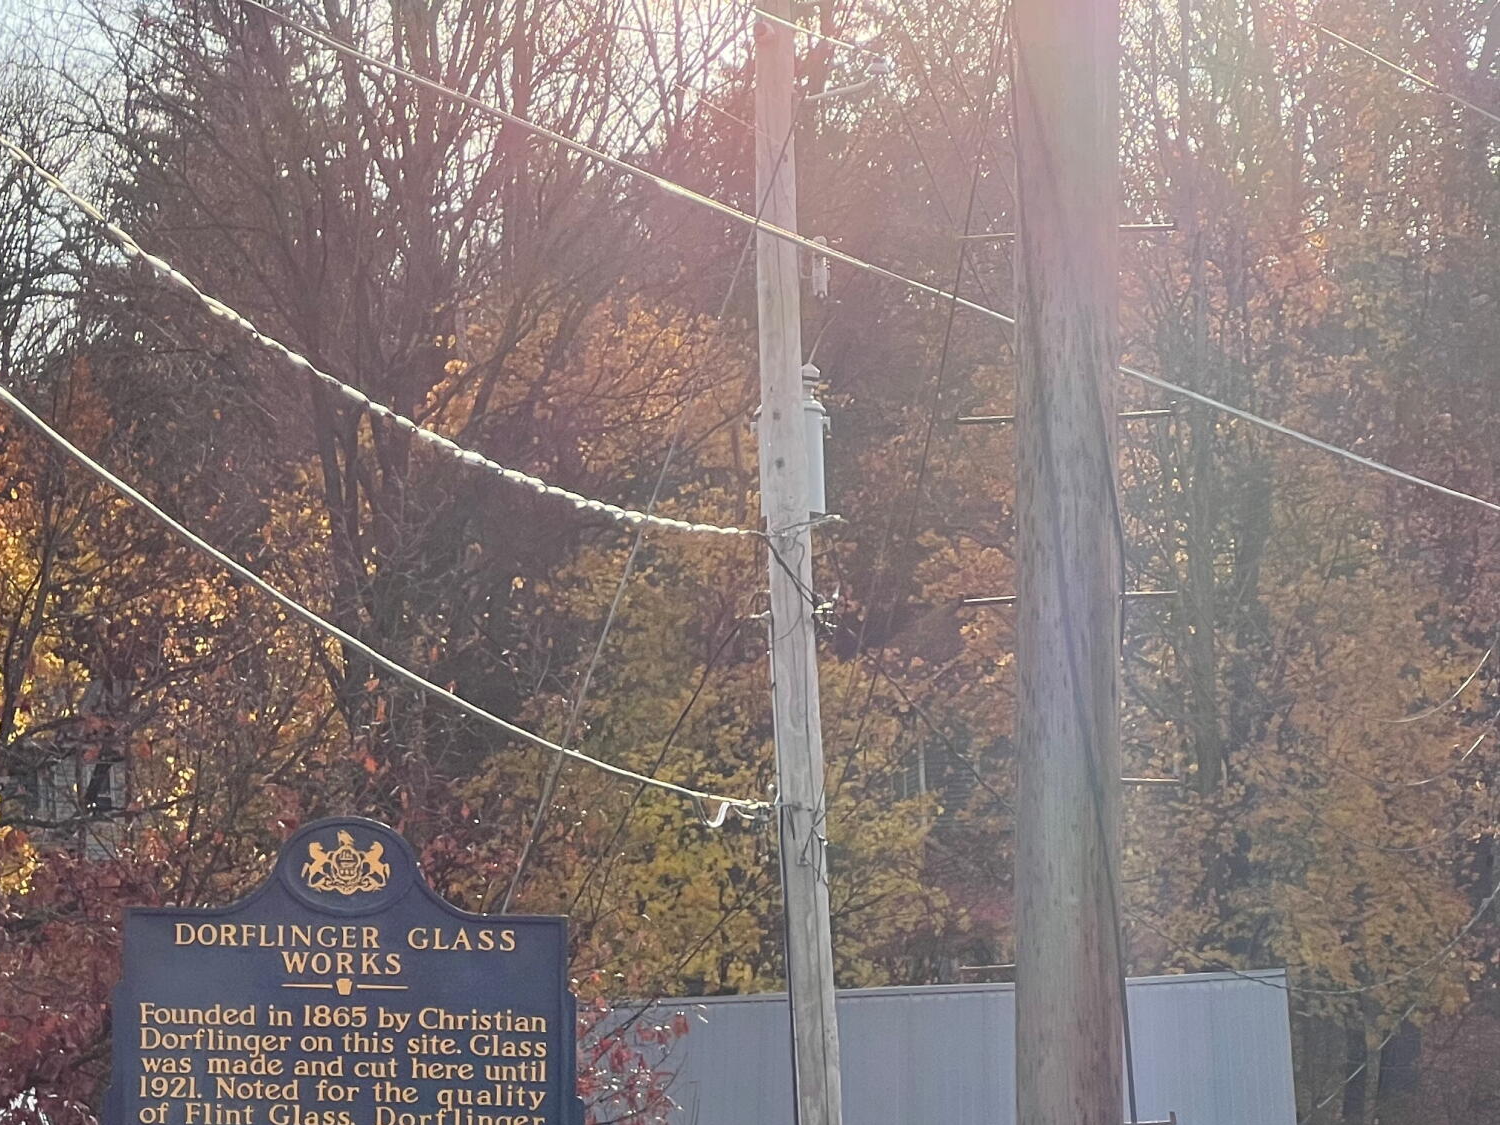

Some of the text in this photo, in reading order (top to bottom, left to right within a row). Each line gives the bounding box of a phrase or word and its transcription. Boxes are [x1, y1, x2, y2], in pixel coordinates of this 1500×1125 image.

[175, 923, 516, 951] DORFLINGER GLASS
[282, 952, 401, 974] WORKS
[140, 1003, 546, 1033] Founded in 1865 by Christian
[140, 1028, 546, 1057] Dorflinger on this site. Glass
[141, 1056, 546, 1082] was made and cut here until
[141, 1077, 545, 1109] 1921. Noted for the quality
[140, 1104, 168, 1125] of
[186, 1105, 253, 1125] Flint
